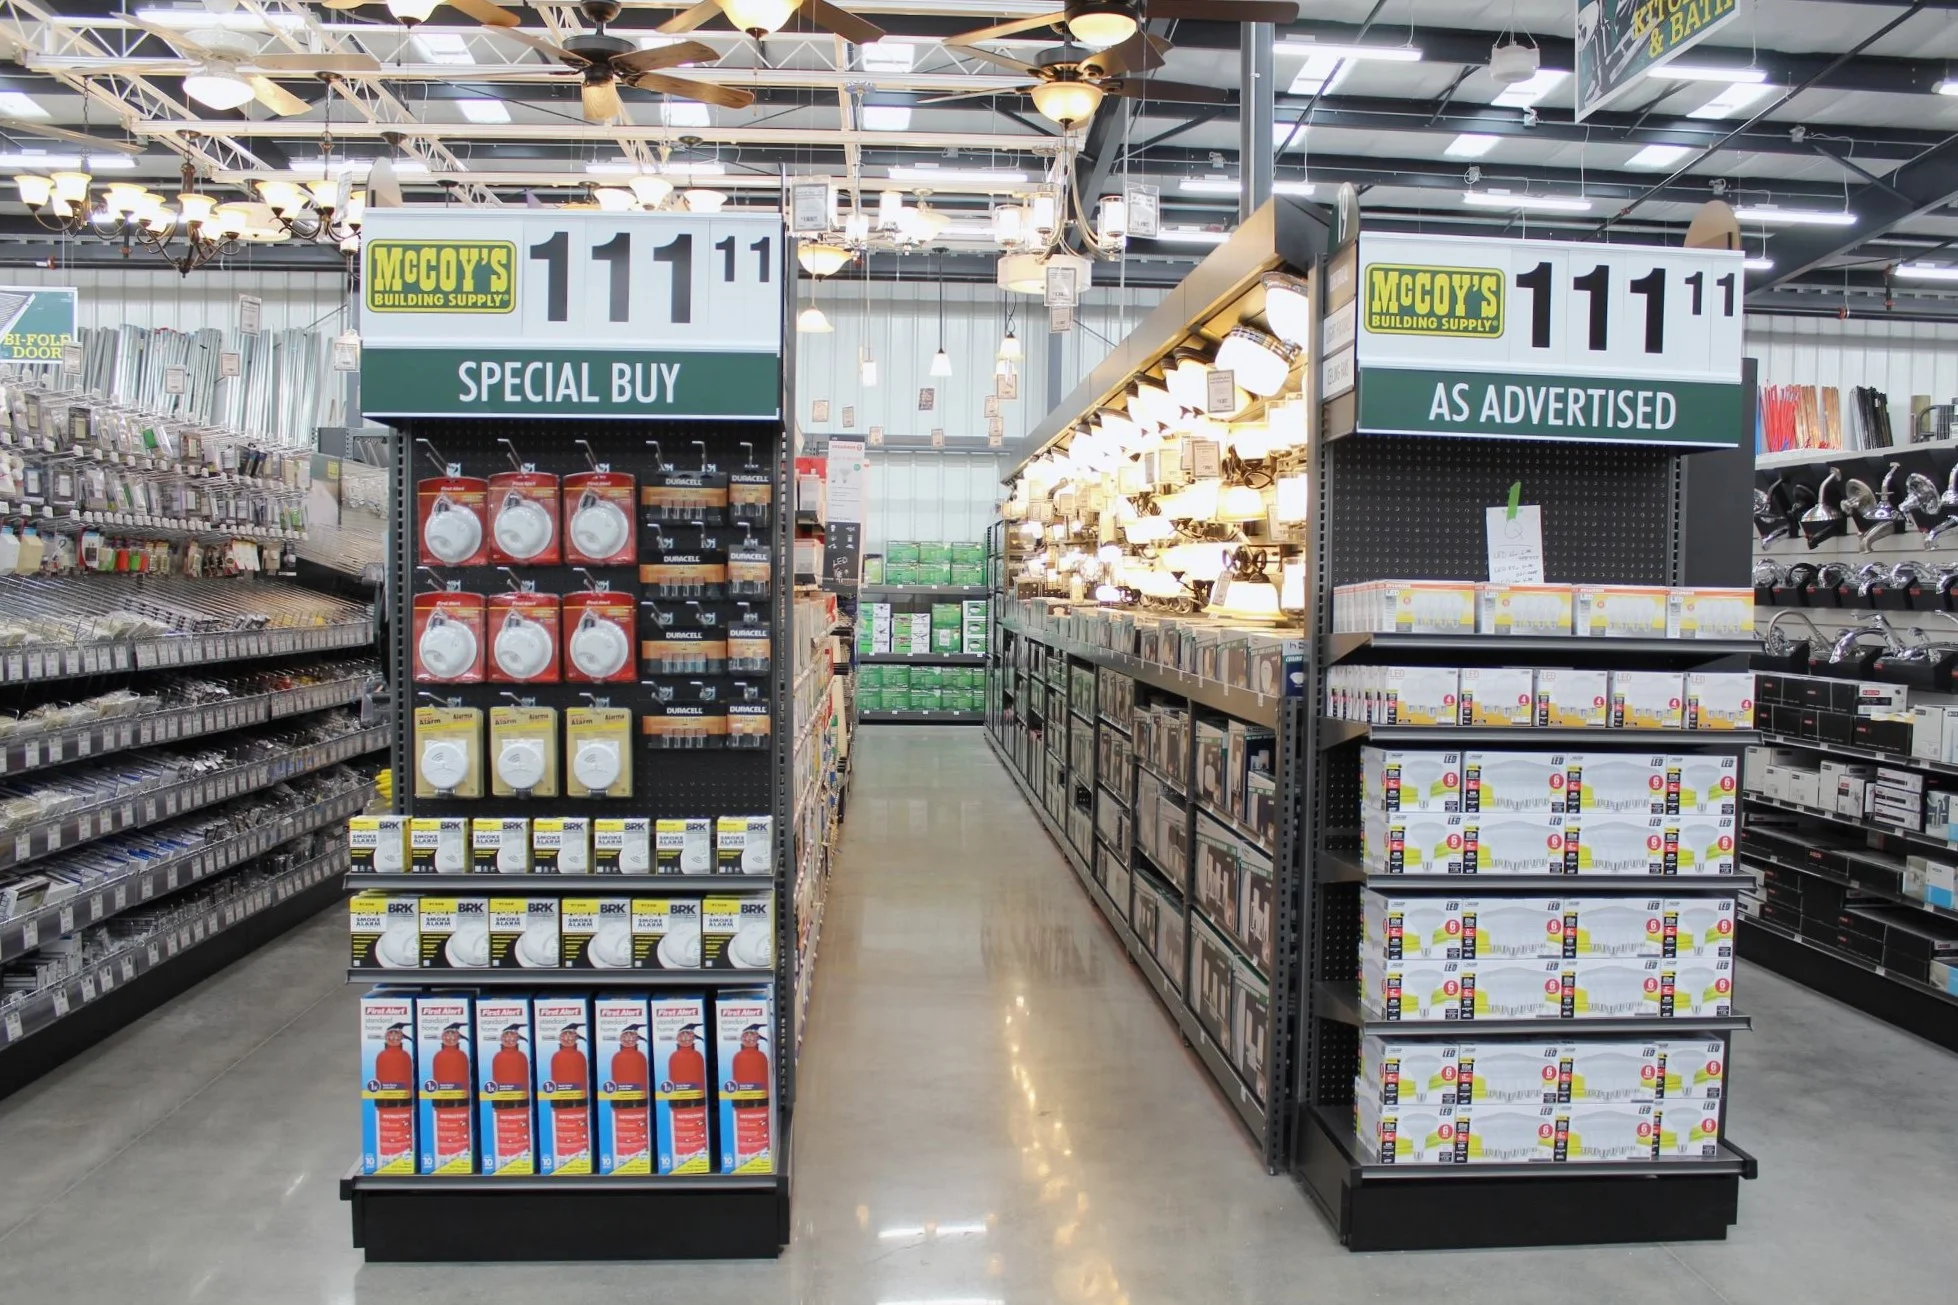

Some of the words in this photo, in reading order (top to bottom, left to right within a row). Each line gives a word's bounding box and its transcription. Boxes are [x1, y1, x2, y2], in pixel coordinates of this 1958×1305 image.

[1649, 27, 1663, 58] &
[374, 247, 508, 292] McCOY'S
[1372, 270, 1498, 318] McCOY'S
[374, 294, 444, 306] BUILDING
[449, 294, 503, 307] SUPPLY
[1371, 314, 1437, 329] BUILDING
[1442, 317, 1492, 332] SUPPLY
[4, 333, 72, 346] BI-FOLD
[458, 361, 600, 402] SPECIAL
[611, 363, 680, 403] BUY
[1429, 382, 1469, 422] AS
[1480, 383, 1676, 430] ADVERTISED
[1721, 759, 1734, 767] LED
[1447, 773, 1454, 783] 6
[1553, 775, 1560, 784] 6
[1653, 777, 1660, 786] 6
[1724, 778, 1731, 787] 6
[1448, 817, 1460, 825] LED
[1451, 835, 1458, 844] 6
[1552, 836, 1558, 845] 6
[1651, 837, 1658, 846] 6
[1722, 837, 1729, 846] 6
[388, 904, 414, 913] BRK
[458, 903, 484, 912] BRK
[528, 904, 554, 912] BRK
[600, 904, 626, 913] BRK
[670, 905, 696, 914] BRK
[741, 905, 766, 913] BRK
[1450, 920, 1456, 930] 6
[1551, 920, 1558, 930] 6
[1650, 920, 1657, 929] 6
[1721, 920, 1728, 929] 6
[1645, 961, 1658, 969] LED
[1448, 981, 1455, 991] 6
[1550, 980, 1556, 990] 6
[1648, 979, 1654, 988] 6
[1720, 980, 1726, 988] 6
[1645, 1067, 1651, 1075] 6
[1710, 1062, 1717, 1071] 6
[1445, 1068, 1452, 1077] 6
[1546, 1067, 1553, 1076] 6
[1641, 1124, 1648, 1133] 6
[1706, 1120, 1712, 1129] 6
[1442, 1126, 1449, 1135] 6
[1543, 1125, 1550, 1134] 6
